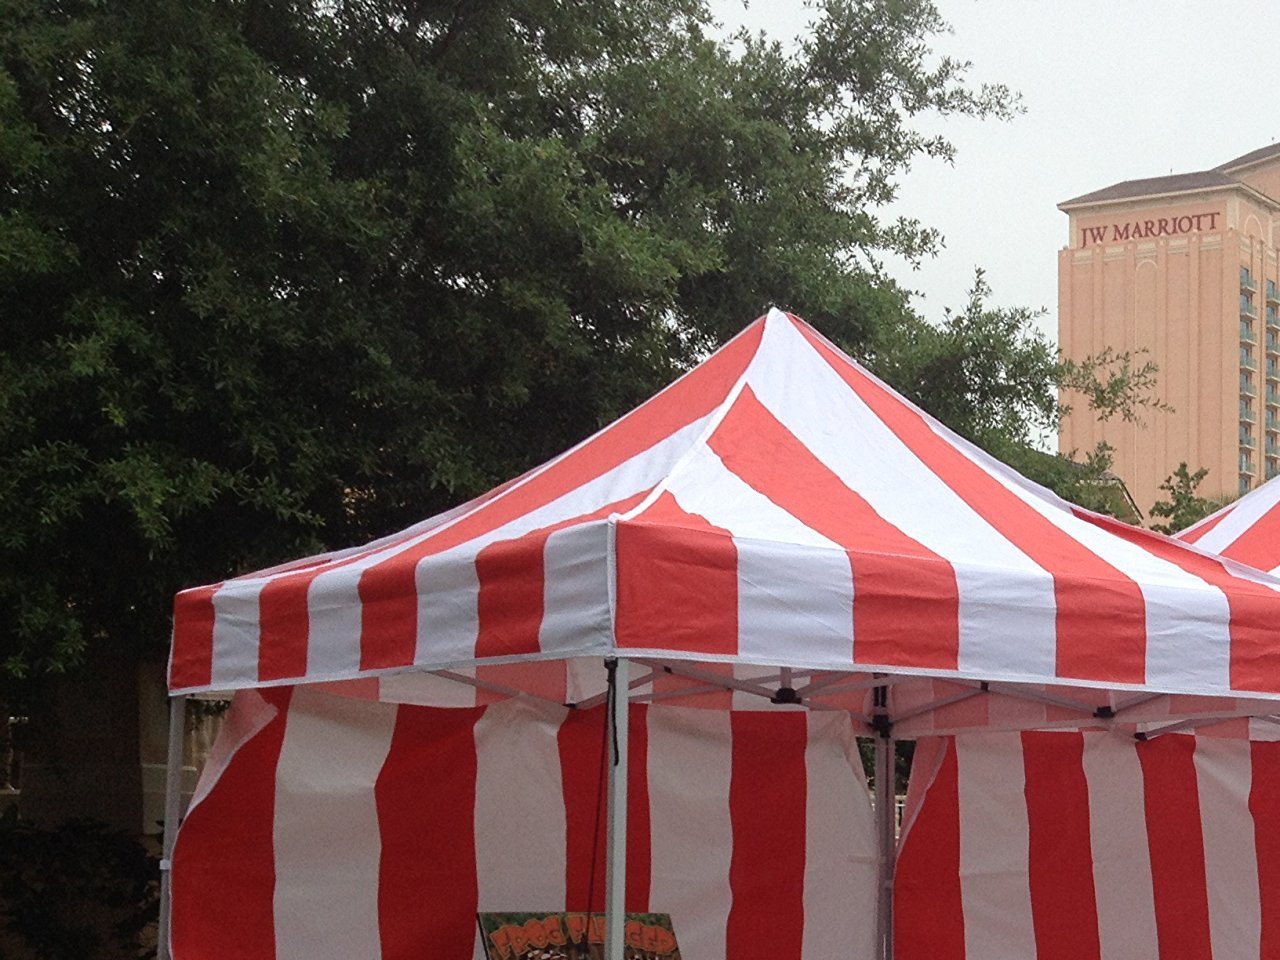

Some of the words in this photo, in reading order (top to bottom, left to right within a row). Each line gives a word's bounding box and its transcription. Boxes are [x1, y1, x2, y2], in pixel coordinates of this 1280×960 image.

[1081, 225, 1108, 248] JW
[1112, 212, 1220, 242] MARRIOTT
[489, 915, 566, 960] FROG
